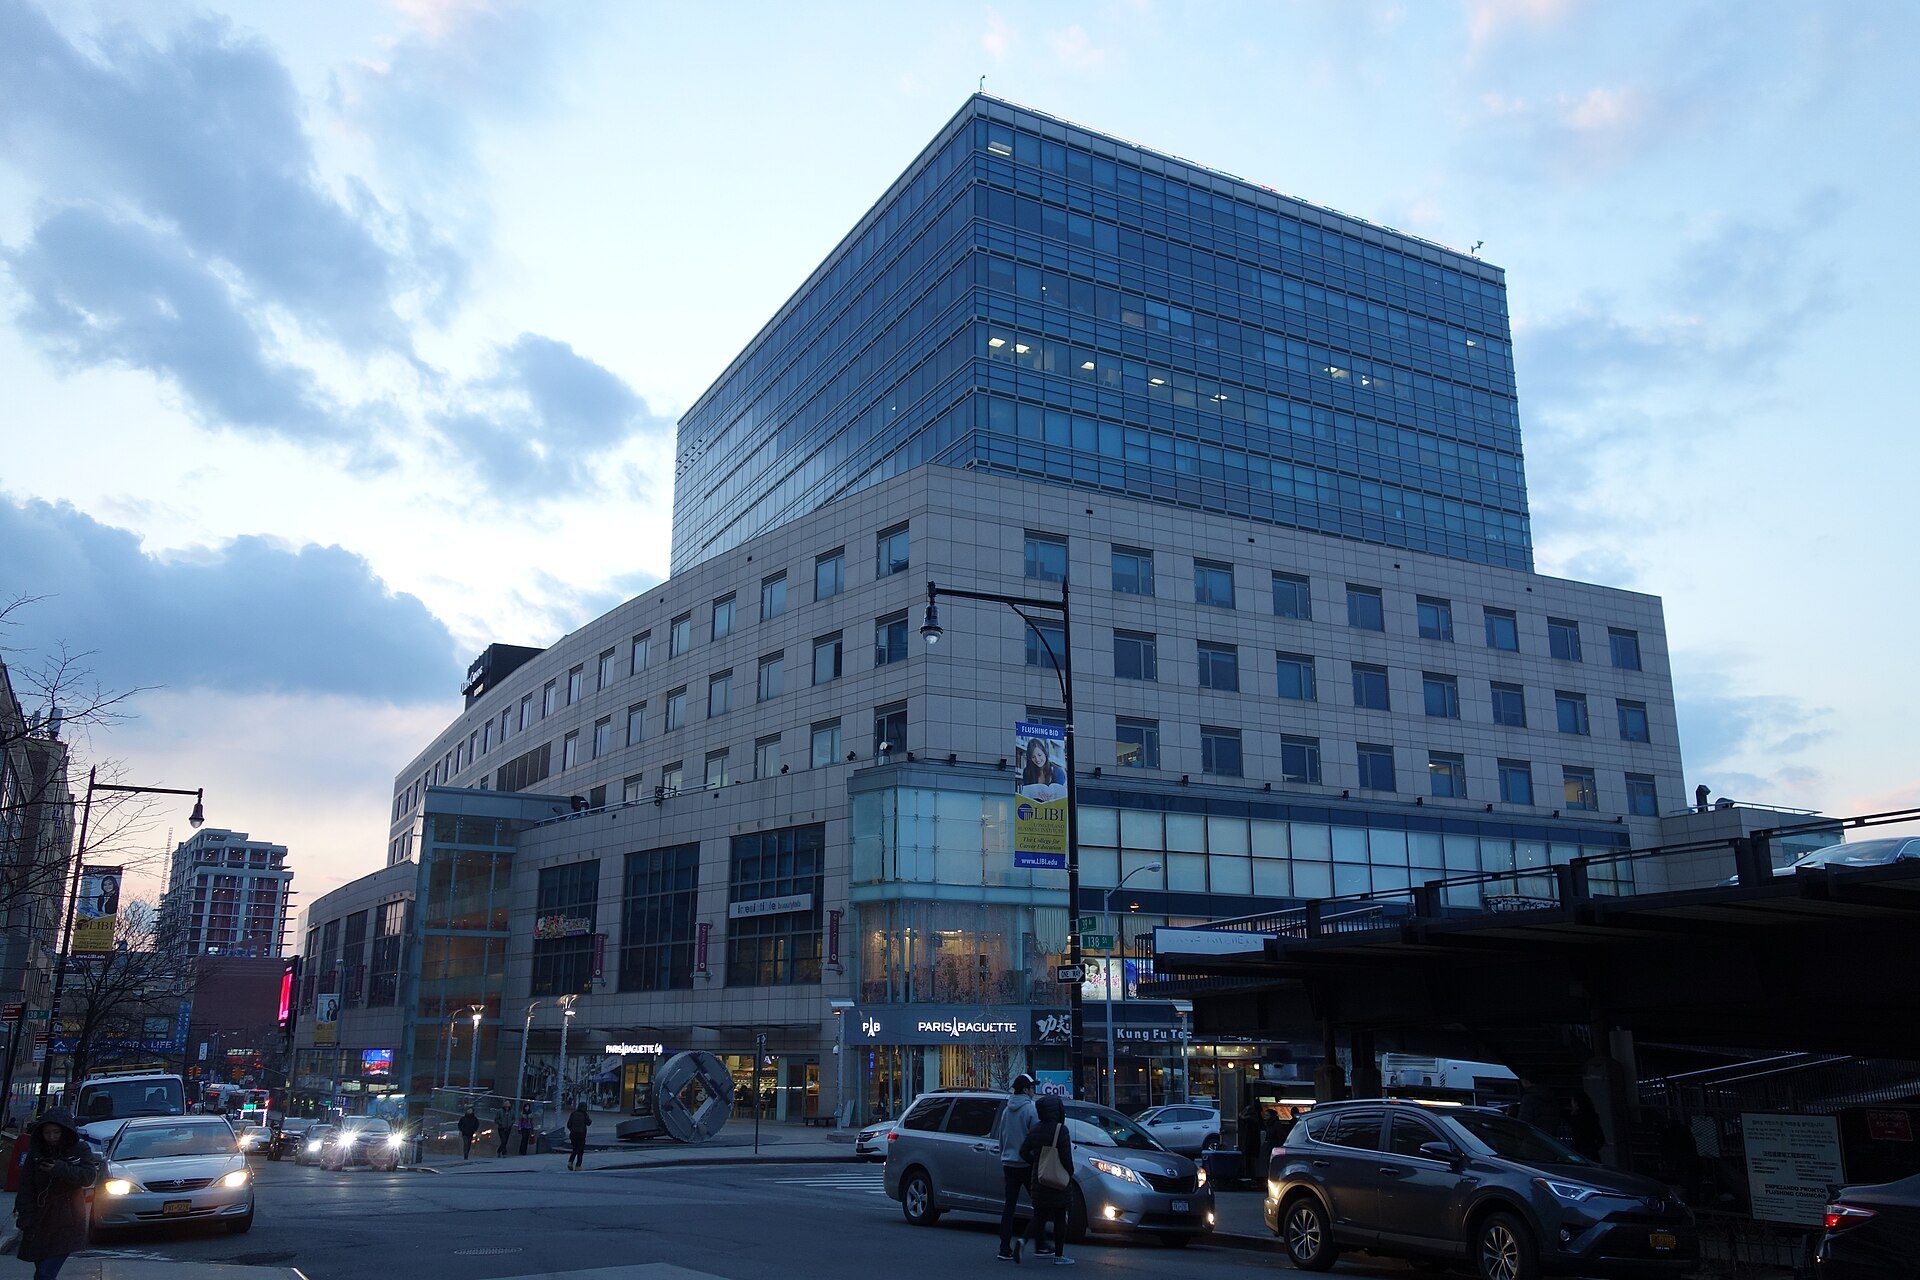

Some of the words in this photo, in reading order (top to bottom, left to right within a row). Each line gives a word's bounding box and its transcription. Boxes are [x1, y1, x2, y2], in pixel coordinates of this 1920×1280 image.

[1021, 725, 1049, 736] FLUSHING
[1049, 729, 1059, 737] BID
[1034, 808, 1064, 821] LIBI
[1021, 858, 1058, 866] www.LIBI.edu
[89, 920, 114, 931] LIBI
[1087, 936, 1100, 947] 138
[1061, 970, 1070, 978] ONE
[1072, 969, 1081, 977] WAY
[27, 1011, 38, 1019] 138
[918, 1022, 951, 1033] PARIS
[958, 1022, 1017, 1033] BAGUETTE
[1117, 1029, 1149, 1041] Kung
[1153, 1029, 1167, 1039] Fu
[151, 1041, 172, 1049] LIFE
[626, 1045, 655, 1054] BAGUETTE
[1765, 1189, 1794, 1197] FLUSHING
[1795, 1191, 1827, 1199] COMMONS
